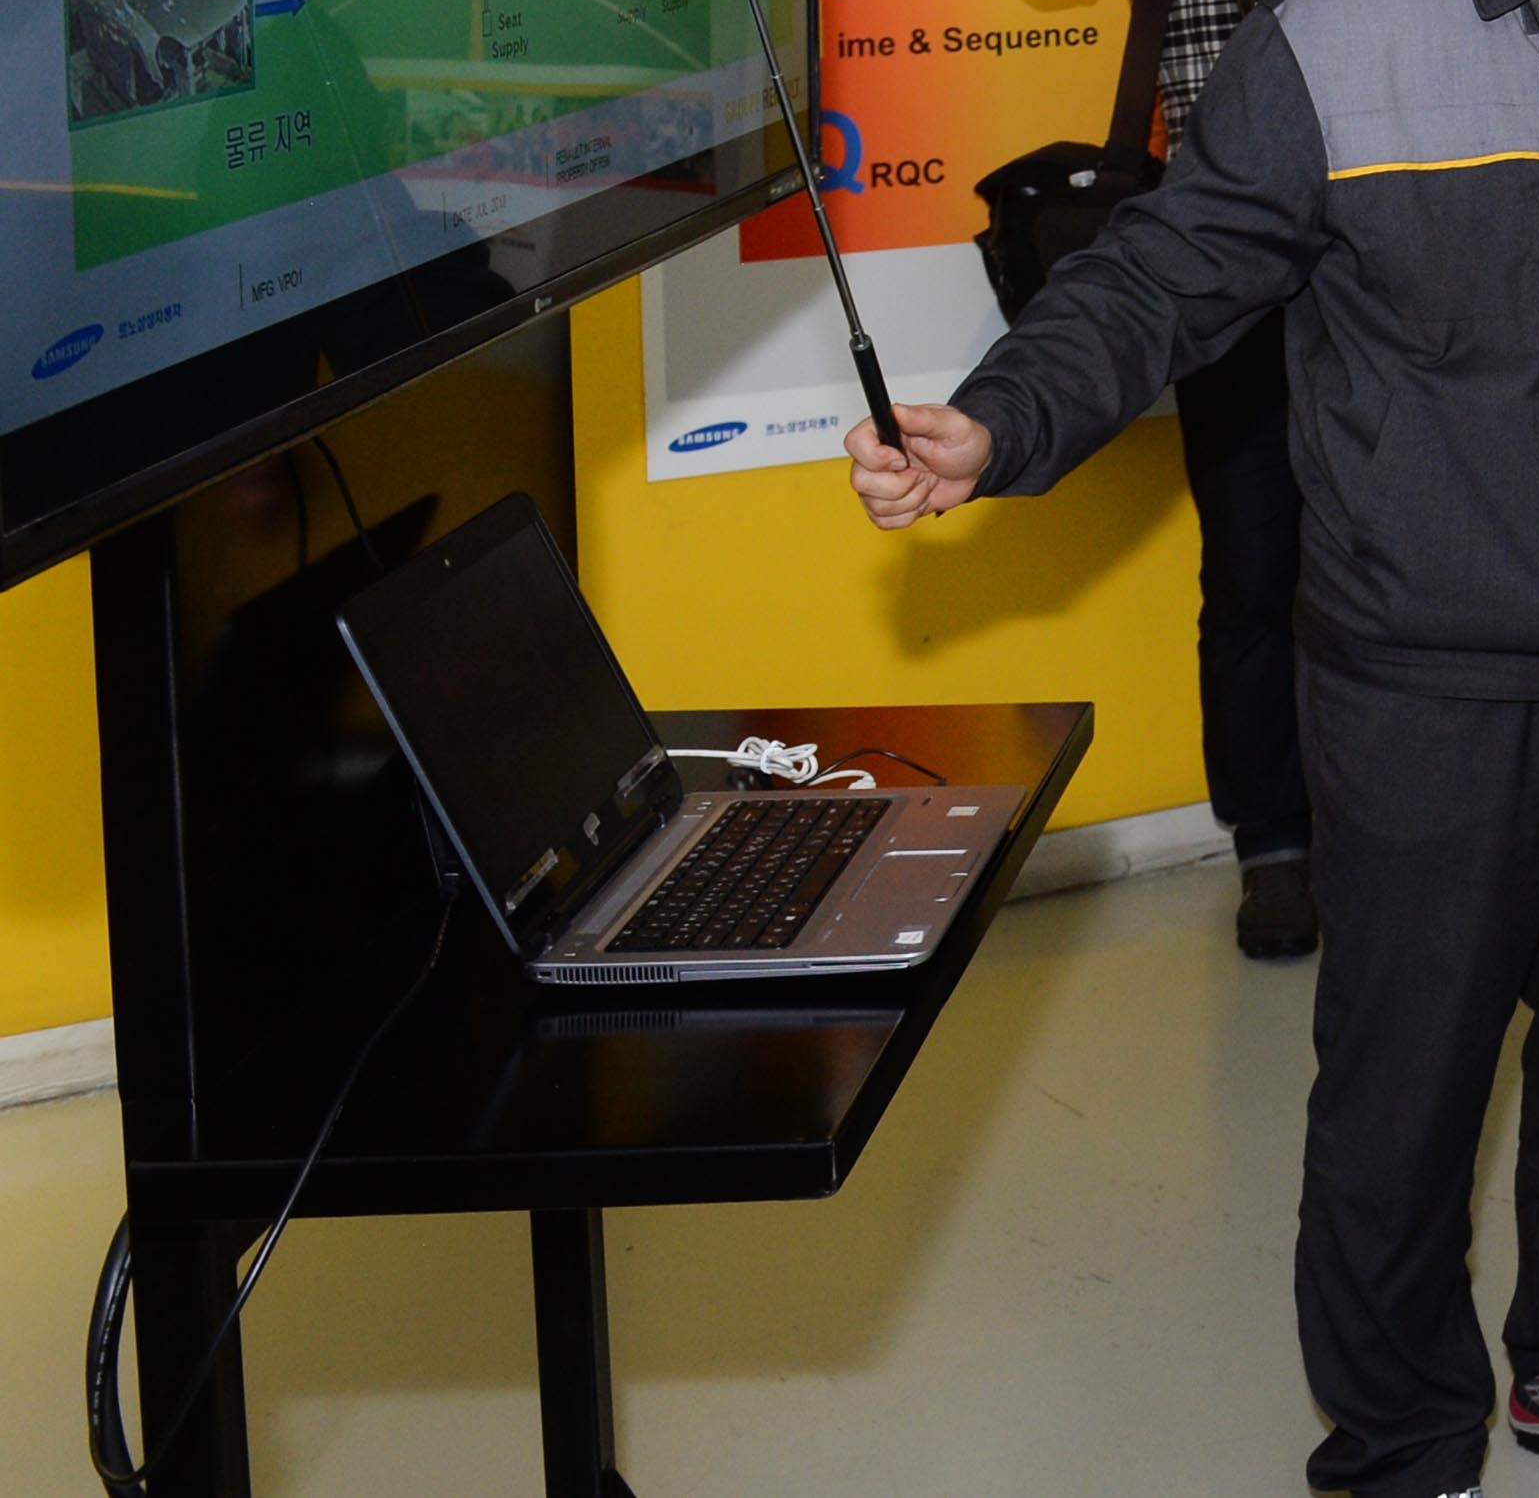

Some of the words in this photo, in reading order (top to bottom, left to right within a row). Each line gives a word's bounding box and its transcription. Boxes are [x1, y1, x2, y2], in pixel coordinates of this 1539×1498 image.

[498, 12, 522, 30] Seat
[491, 35, 529, 60] Supply
[908, 28, 931, 54] &
[943, 23, 1098, 57] Sequence
[224, 120, 267, 171] 물류
[274, 109, 312, 153] 지역
